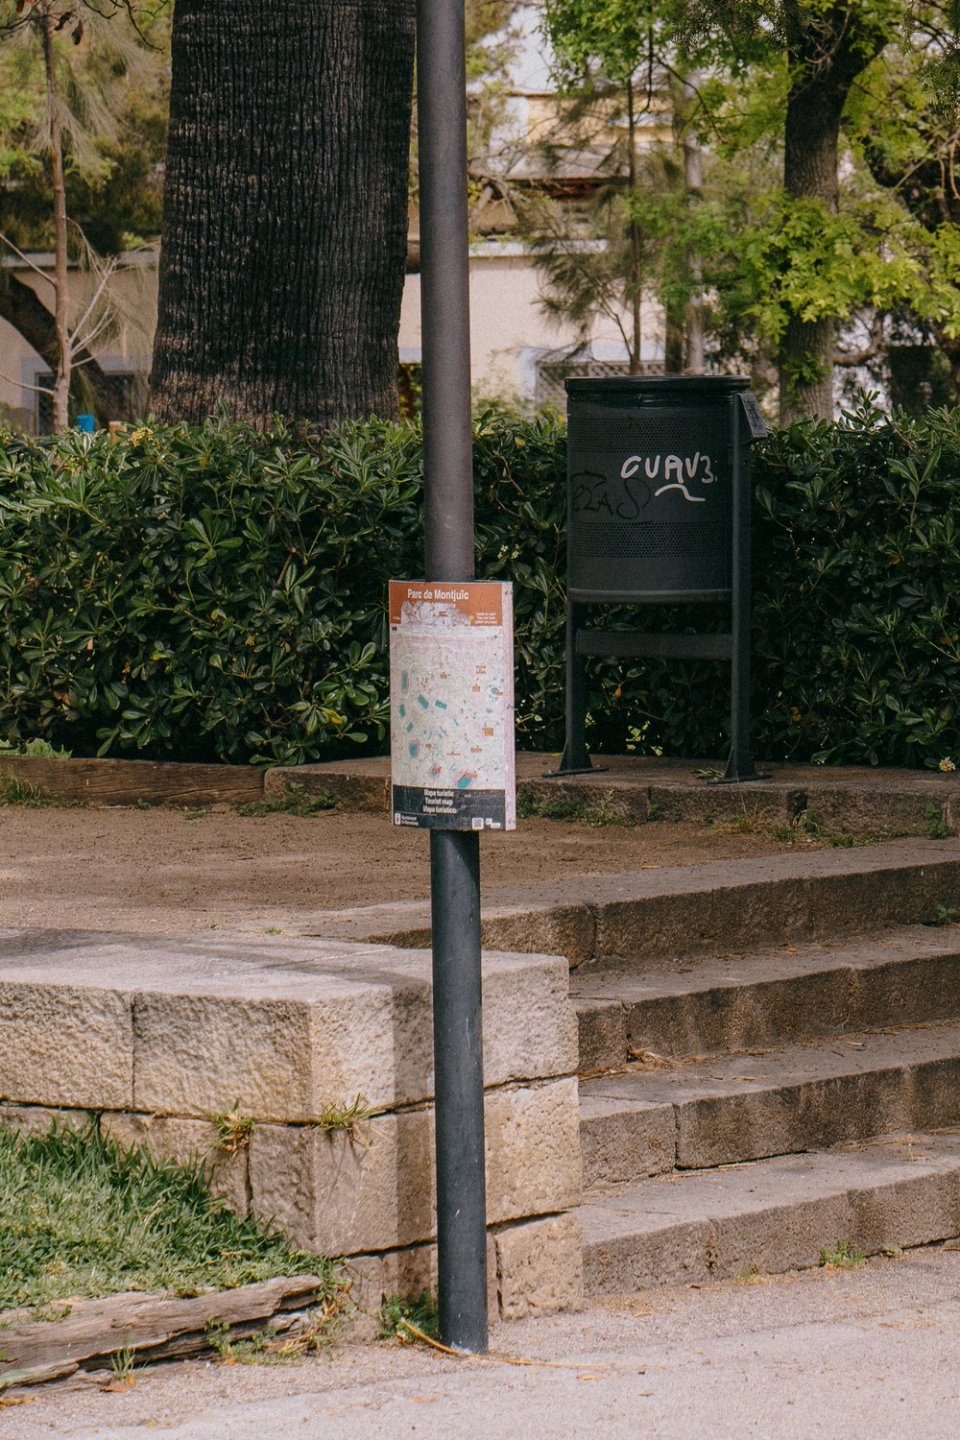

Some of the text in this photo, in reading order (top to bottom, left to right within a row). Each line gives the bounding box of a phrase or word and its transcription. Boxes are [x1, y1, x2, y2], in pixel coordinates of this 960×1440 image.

[407, 588, 469, 602] Parc de Montjuïc
